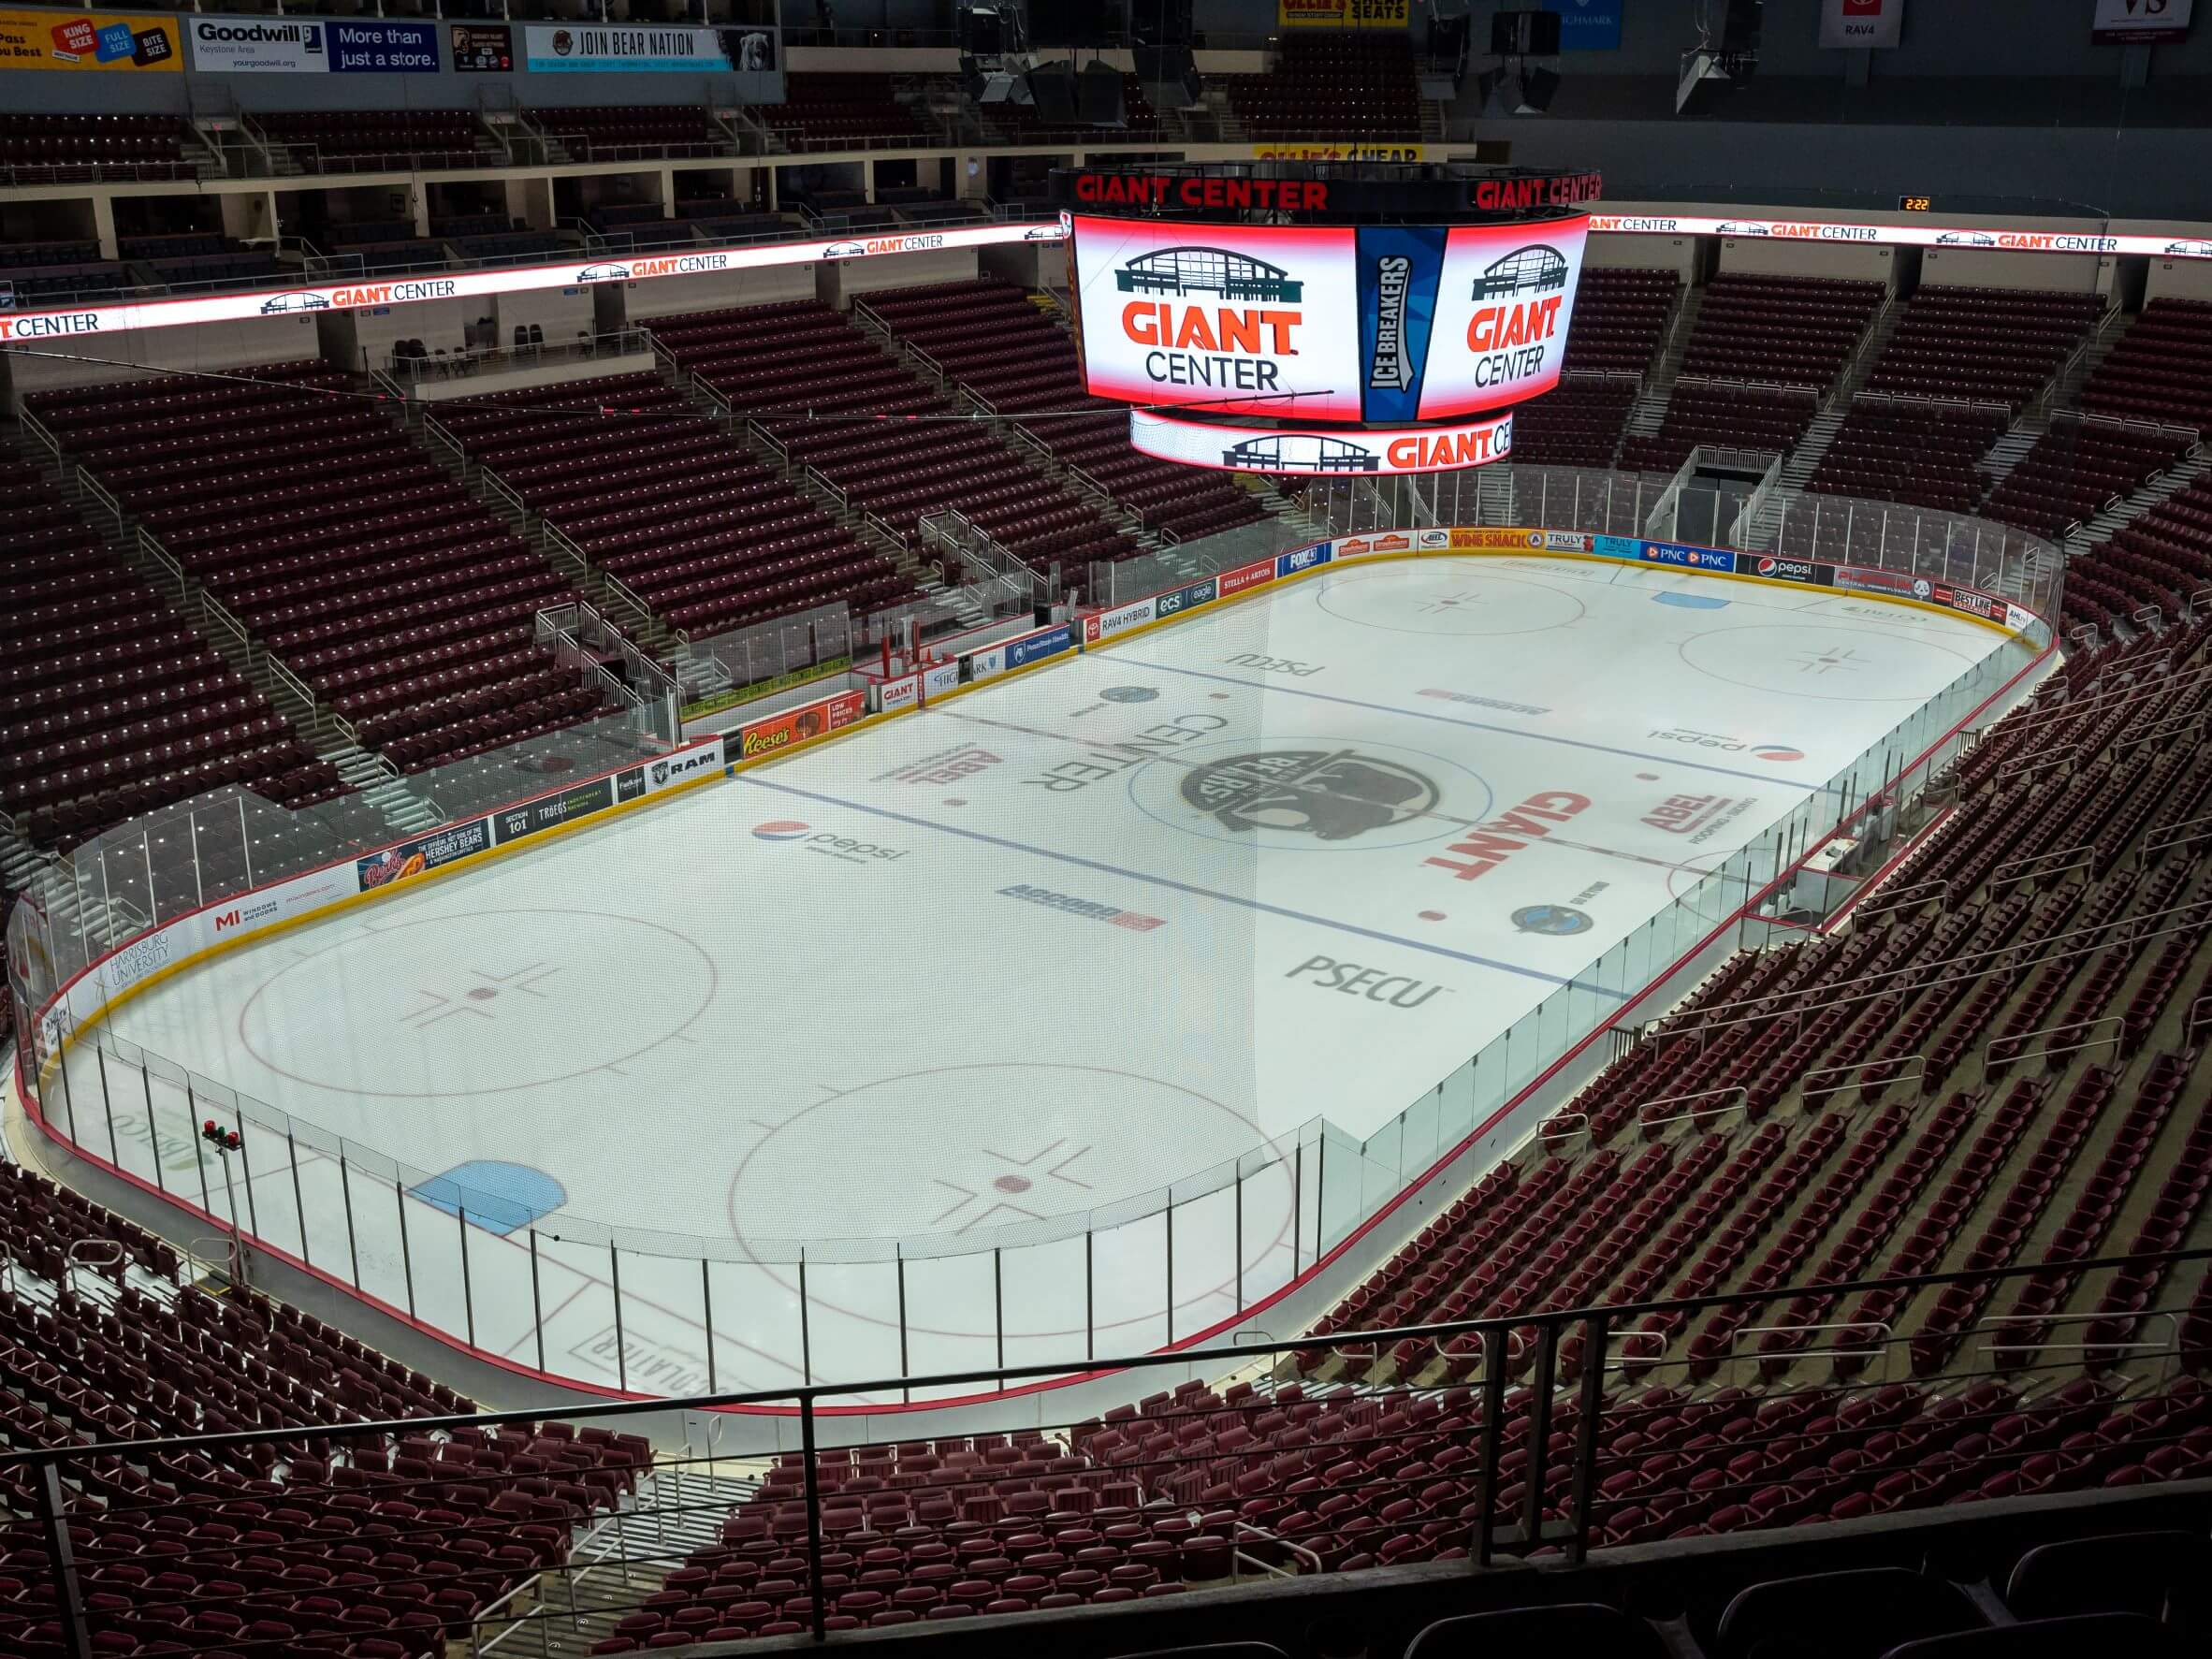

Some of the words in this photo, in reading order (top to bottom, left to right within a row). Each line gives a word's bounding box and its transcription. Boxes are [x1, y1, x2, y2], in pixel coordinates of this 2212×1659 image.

[1352, 6, 1404, 19] SEATS
[1563, 14, 1613, 26] IGHMARK
[64, 23, 91, 38] KING
[105, 30, 128, 43] FULL
[198, 23, 300, 42] Goodwill
[1845, 24, 1875, 36] RAV4
[69, 36, 94, 50] SIZE
[109, 40, 131, 53] SIZE
[143, 34, 164, 47] BITE
[340, 32, 381, 44] More
[386, 33, 422, 48] than
[580, 32, 608, 55] JOIN
[613, 32, 646, 55] BEAR
[650, 33, 693, 55] NATION
[14, 47, 42, 57] Best
[147, 44, 167, 57] SIZE
[341, 51, 371, 69] just
[376, 54, 386, 66] a
[391, 50, 437, 66] store.
[1076, 173, 1171, 205] GIANT
[1181, 177, 1329, 211] CENTER
[1476, 179, 1549, 211] GIANT
[1549, 173, 1603, 205] CENTER
[1906, 198, 1928, 211] 2:22
[1588, 218, 1622, 229] ANT
[1623, 219, 1678, 231] CENTER
[1771, 225, 1821, 237] GIANT
[1822, 226, 1878, 240] CENTER
[866, 239, 905, 254] GIANT
[905, 235, 943, 251] CENTER
[1998, 235, 2055, 249] GIANT
[2056, 236, 2118, 251] CENTER
[632, 259, 679, 277] GIANT
[679, 254, 728, 272] CENTER
[332, 286, 393, 306] GIANT
[394, 281, 457, 300] CENTER
[16, 313, 98, 337] CENTER
[1122, 300, 1302, 356] GIANT
[1370, 256, 1411, 388] ICEBREAKERS
[1466, 295, 1563, 353] GIANT
[1145, 351, 1279, 391] CENTER
[1475, 345, 1545, 388] CENTER
[1387, 431, 1492, 470] GIANT
[1548, 533, 1582, 545] TRULY
[1605, 537, 1634, 547] TRULY
[1660, 548, 1686, 562] PNC
[1700, 553, 1726, 568] PNC
[1778, 562, 1812, 575] pepsi
[1224, 575, 1245, 589] STELLA
[1955, 591, 1975, 605] BEST
[1975, 596, 1991, 609] LINE
[1102, 617, 1122, 631] RAV4
[1123, 606, 1151, 625] HYBRID
[1226, 654, 1325, 677] PSECU
[884, 683, 914, 700] GIANT
[1647, 731, 1748, 751] pepsi
[1021, 714, 1229, 793] CENTER
[670, 752, 716, 775] RAM
[505, 810, 529, 823] SECTION
[509, 818, 527, 834] 101
[1421, 792, 1592, 881] GIANT
[425, 839, 459, 861] HERSHEY
[459, 832, 484, 850] BEARS
[806, 834, 910, 860] pepsi
[242, 901, 278, 916] WINDOWS
[254, 907, 278, 919] DOORS
[215, 909, 240, 932] MI
[111, 935, 168, 971] HARRISBURG
[112, 945, 169, 987] UNIVERSITY
[1285, 955, 1443, 1009] PSECU
